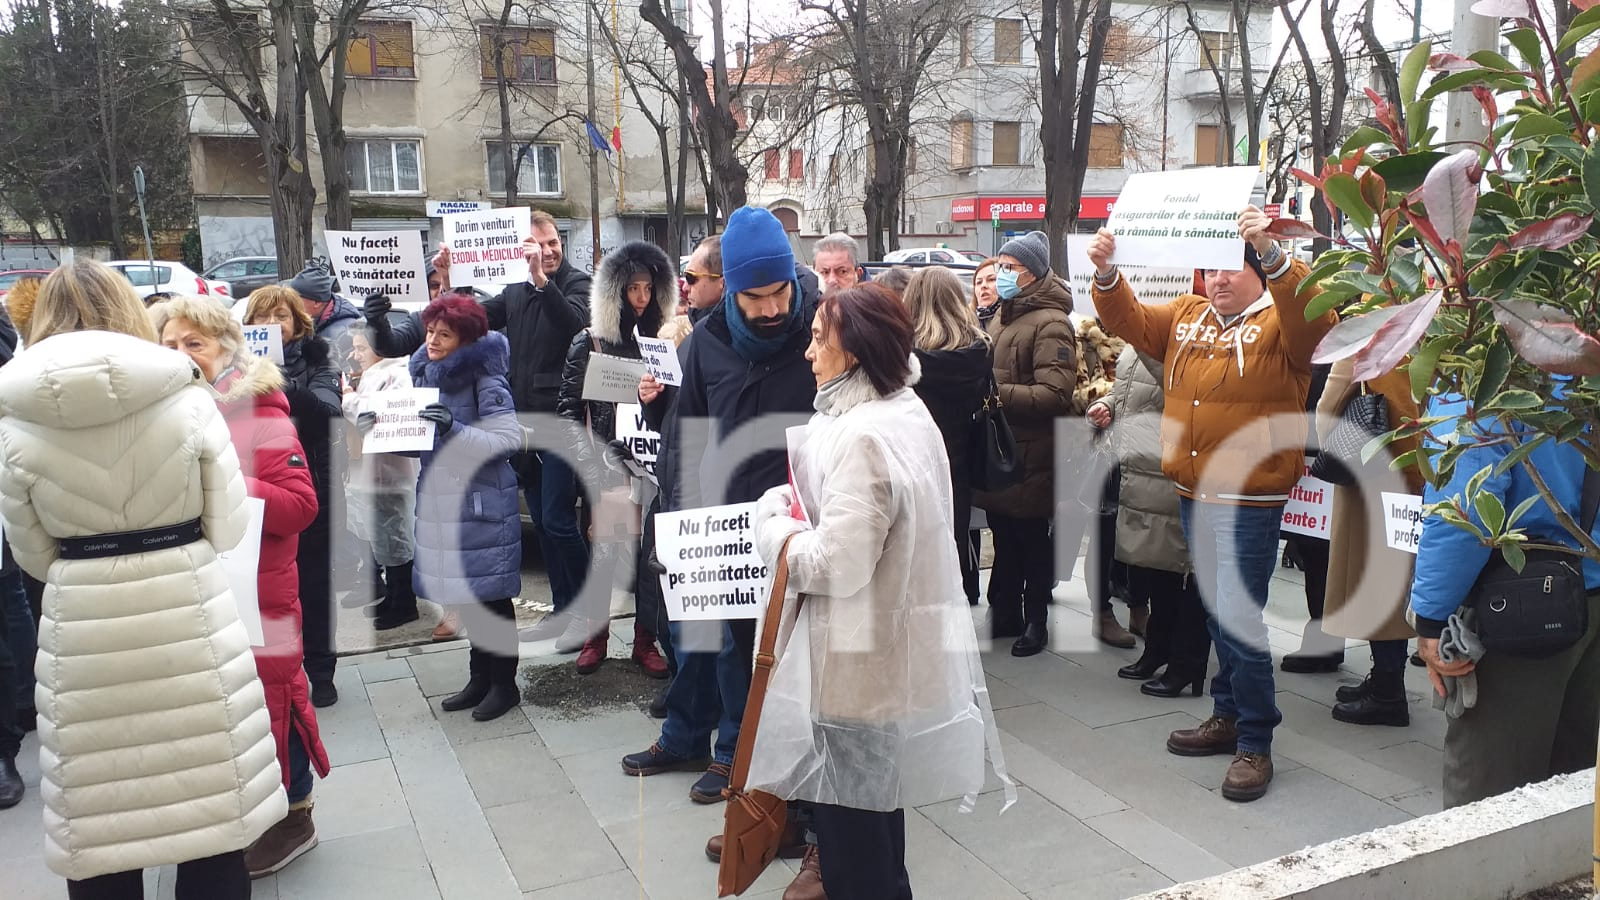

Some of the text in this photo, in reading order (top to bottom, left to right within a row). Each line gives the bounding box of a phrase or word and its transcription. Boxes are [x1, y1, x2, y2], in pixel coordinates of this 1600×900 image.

[1164, 194, 1200, 203] Fondul
[1178, 210, 1191, 220] de
[456, 216, 515, 233] Dorim venituri
[455, 231, 518, 248] care sa prevină
[1113, 226, 1125, 236] să
[1171, 226, 1181, 237] la
[1184, 228, 1240, 239] sănătate!
[342, 236, 399, 251] Nu faceți
[344, 252, 401, 264] economie
[452, 247, 525, 264] EXODUL MEDICILOR
[340, 268, 415, 280] pe sănătatea
[473, 264, 505, 280] din țară
[1130, 273, 1142, 283] de
[349, 284, 402, 296] poporului
[396, 427, 427, 437] MEDICILOR
[679, 512, 750, 536] Nu faceți
[142, 534, 178, 545] Calvin Klein
[679, 537, 753, 560] economie
[669, 572, 685, 589] pe
[682, 587, 756, 612] poporului
